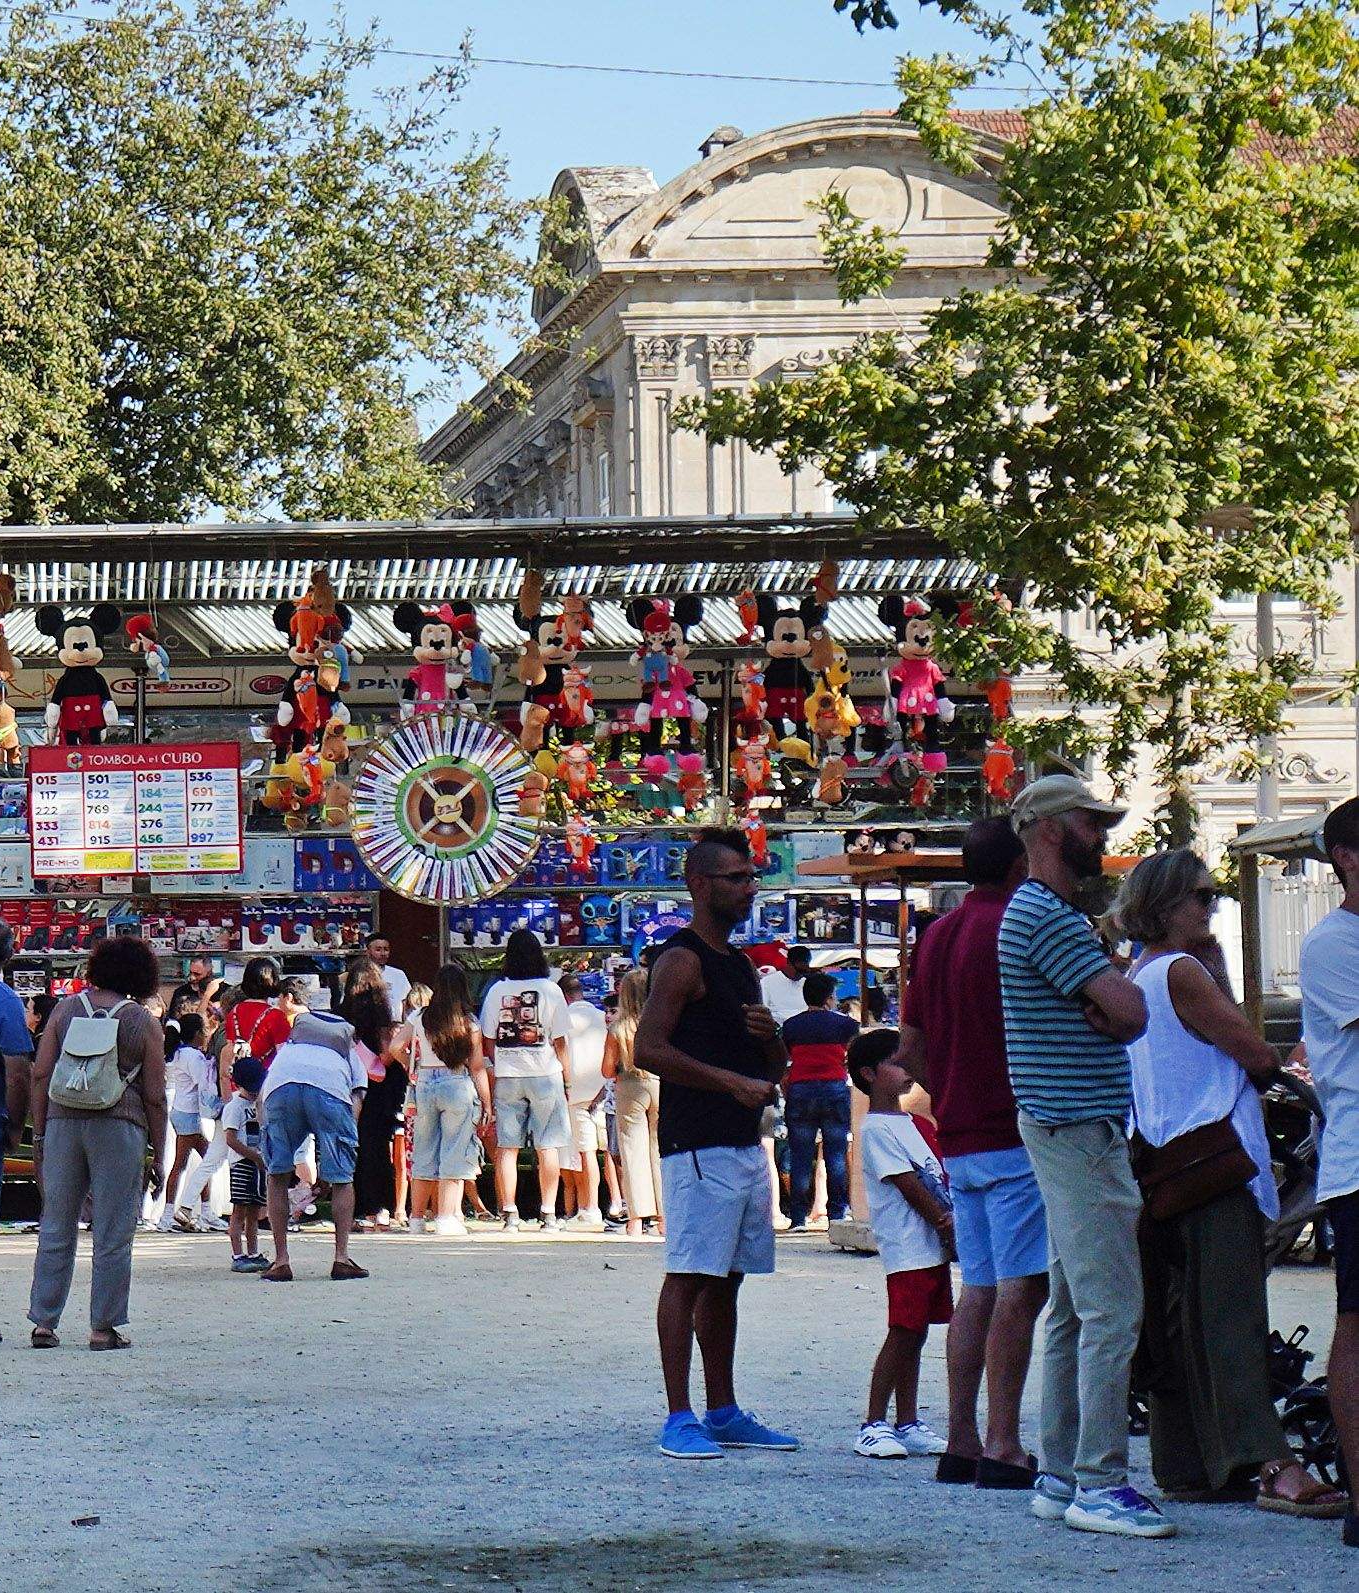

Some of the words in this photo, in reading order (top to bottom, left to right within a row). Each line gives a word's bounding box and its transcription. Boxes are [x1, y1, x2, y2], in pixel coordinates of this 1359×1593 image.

[88, 754, 146, 766] TOMBOLA
[161, 752, 203, 764] CUBO
[36, 775, 57, 785] 015
[88, 774, 109, 784] 501
[137, 773, 161, 783] 069
[189, 772, 213, 782] 536
[39, 791, 56, 800] 117
[87, 790, 109, 800] 622
[192, 787, 213, 797] 691
[36, 806, 58, 815] 222
[87, 805, 109, 814] 769
[139, 804, 162, 813] 244
[191, 803, 213, 812] 777
[36, 821, 59, 831] 333
[88, 820, 111, 829] 814
[141, 819, 163, 828] 376
[38, 837, 59, 846] 431
[90, 835, 110, 845] 915
[139, 834, 163, 844] 456
[191, 833, 214, 843] 997
